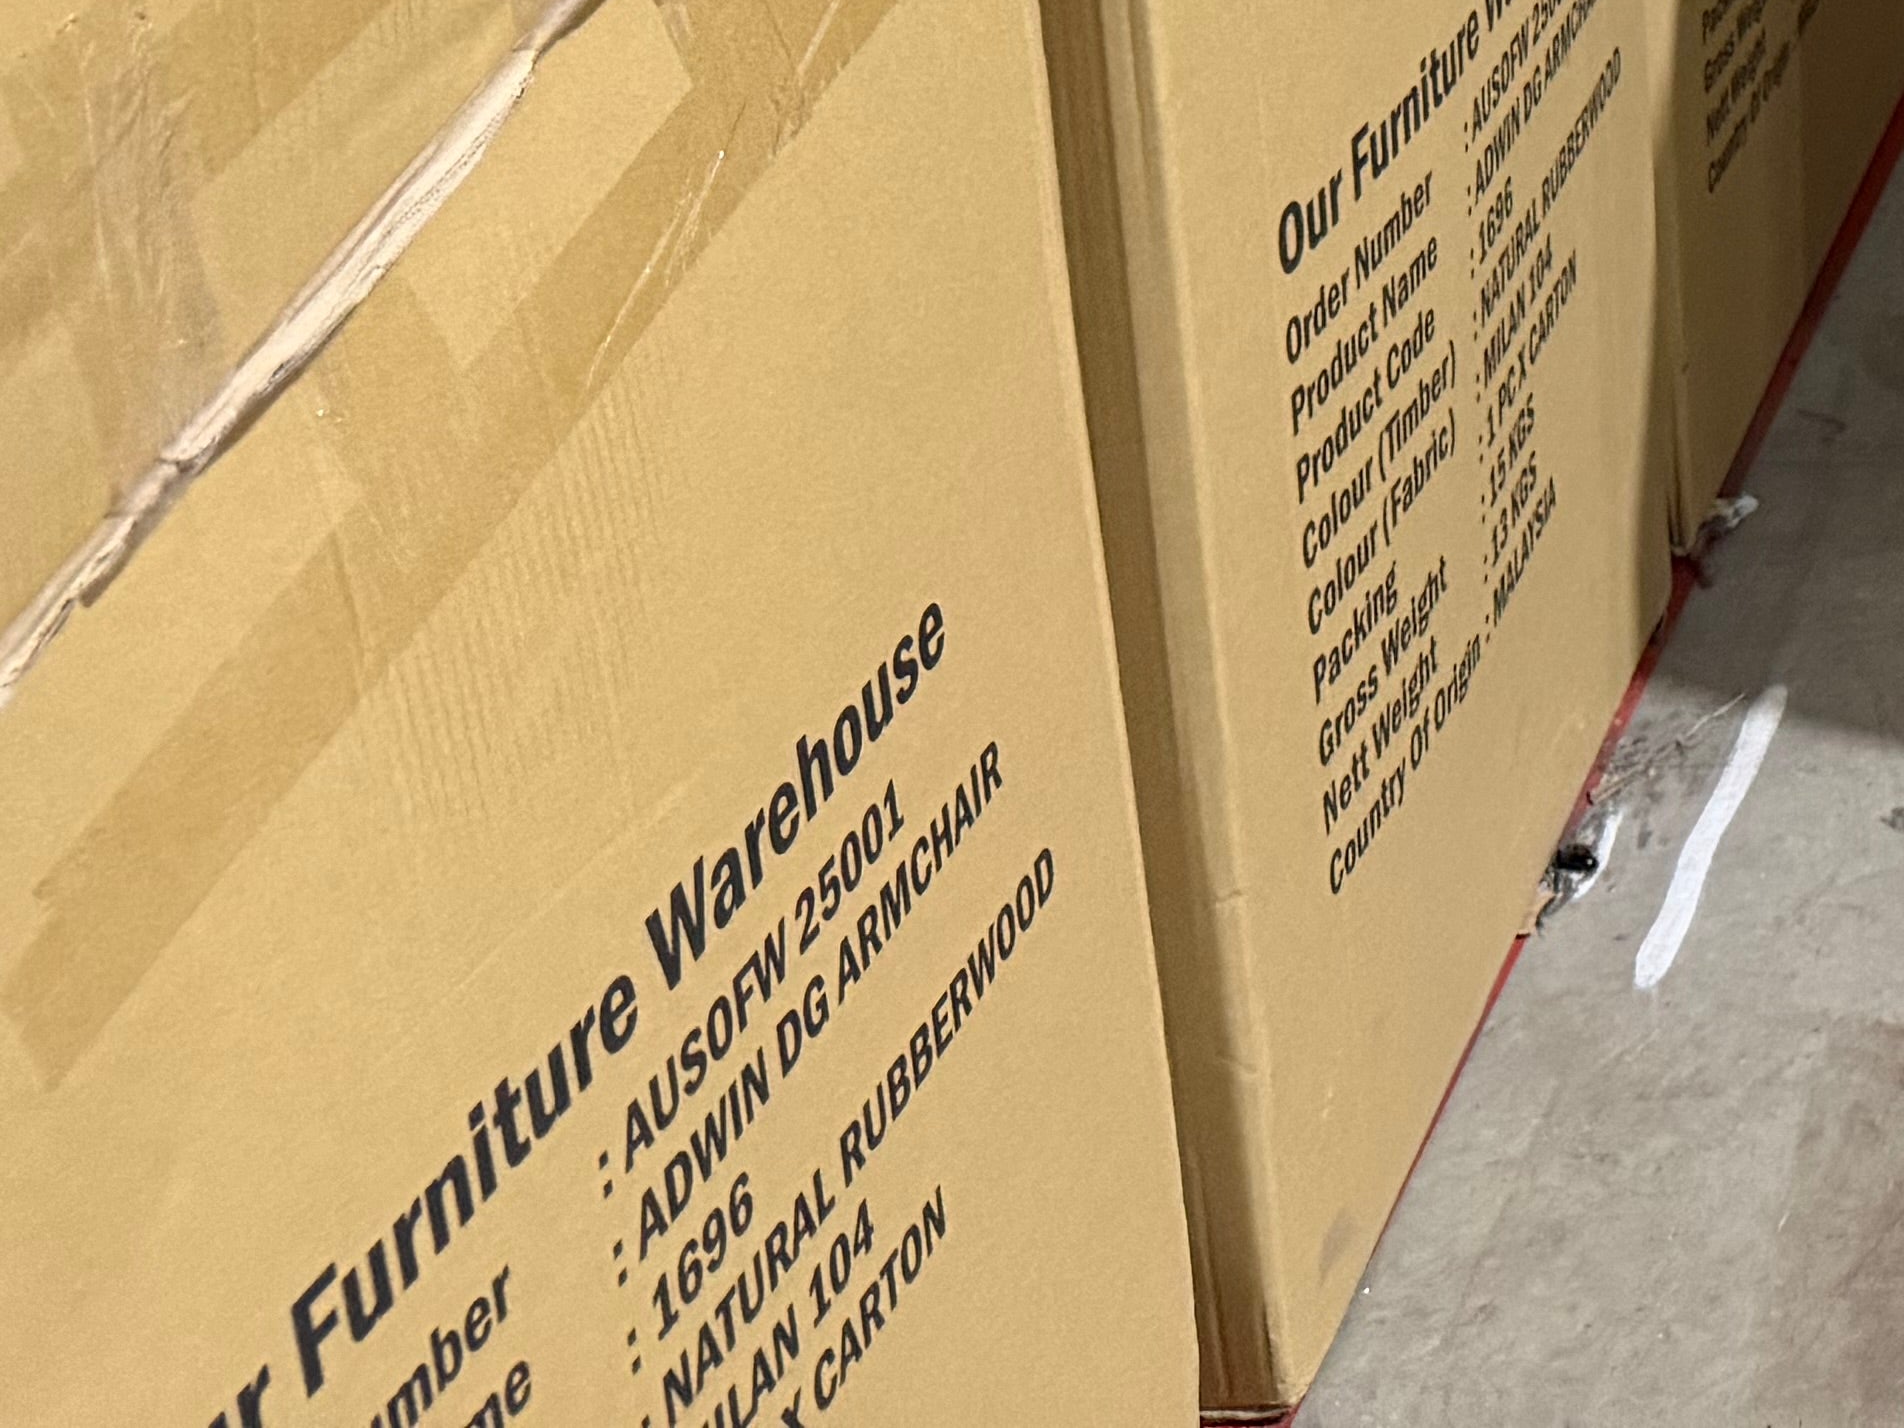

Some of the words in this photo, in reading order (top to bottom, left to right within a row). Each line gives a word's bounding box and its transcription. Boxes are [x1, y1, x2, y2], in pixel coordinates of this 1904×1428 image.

[1277, 168, 1343, 275] Our
[1350, 9, 1480, 203] Furniture
[1285, 266, 1350, 365] Order
[1354, 170, 1433, 291] Number
[1290, 301, 1379, 437] Product
[1381, 236, 1438, 329] Name
[1295, 366, 1383, 505] Product
[1386, 308, 1435, 390] Code
[1302, 455, 1374, 569] Colour
[1377, 339, 1456, 483] (Timber)
[1307, 519, 1378, 636] Colour
[1382, 407, 1456, 548] (Fabric)
[1312, 559, 1398, 706] Packing
[1318, 663, 1379, 767] Gross
[1380, 555, 1448, 677] Weight
[1322, 739, 1371, 837] Nett
[1371, 634, 1438, 760] Weight
[1329, 756, 1406, 895] Country
[1433, 633, 1481, 733] Origin
[290, 974, 638, 1399] Furniture
[644, 602, 946, 991] Warehouse
[624, 915, 786, 1175] AUSOFW
[794, 778, 905, 956] 25001
[638, 1045, 770, 1263] ADWIN
[775, 974, 830, 1079] DG
[837, 740, 1003, 1006] ARMCHAIR
[662, 1167, 836, 1428] NATURAL
[839, 847, 1055, 1189] RUBBERWOOD
[652, 1171, 754, 1342] 1696
[808, 1197, 875, 1329] 104
[813, 1183, 946, 1412] CARTON
